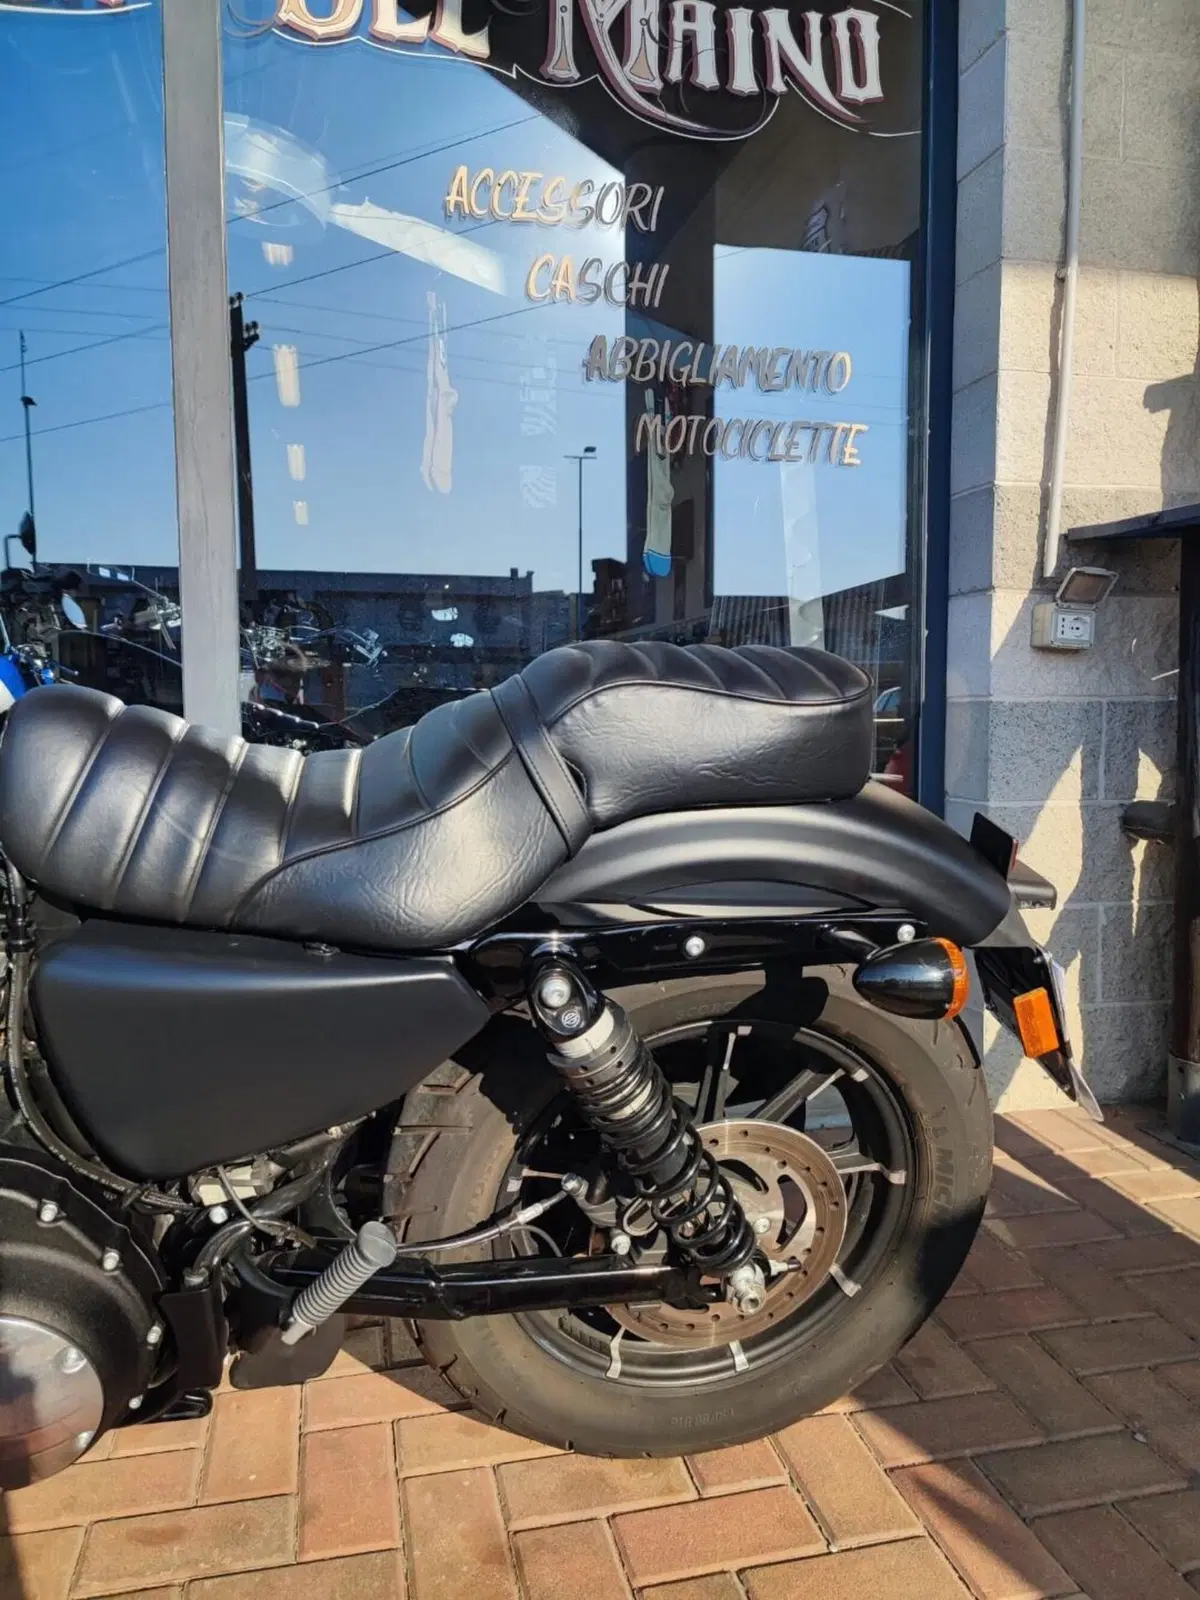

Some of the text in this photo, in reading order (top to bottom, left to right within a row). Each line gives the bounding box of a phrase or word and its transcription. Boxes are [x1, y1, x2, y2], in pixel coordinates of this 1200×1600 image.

[445, 165, 665, 233] ACCESSORI
[525, 253, 670, 308] CASCHI
[582, 334, 852, 396] ABBIGLIAMENTO
[634, 413, 869, 467] MOTOCICLETTE
